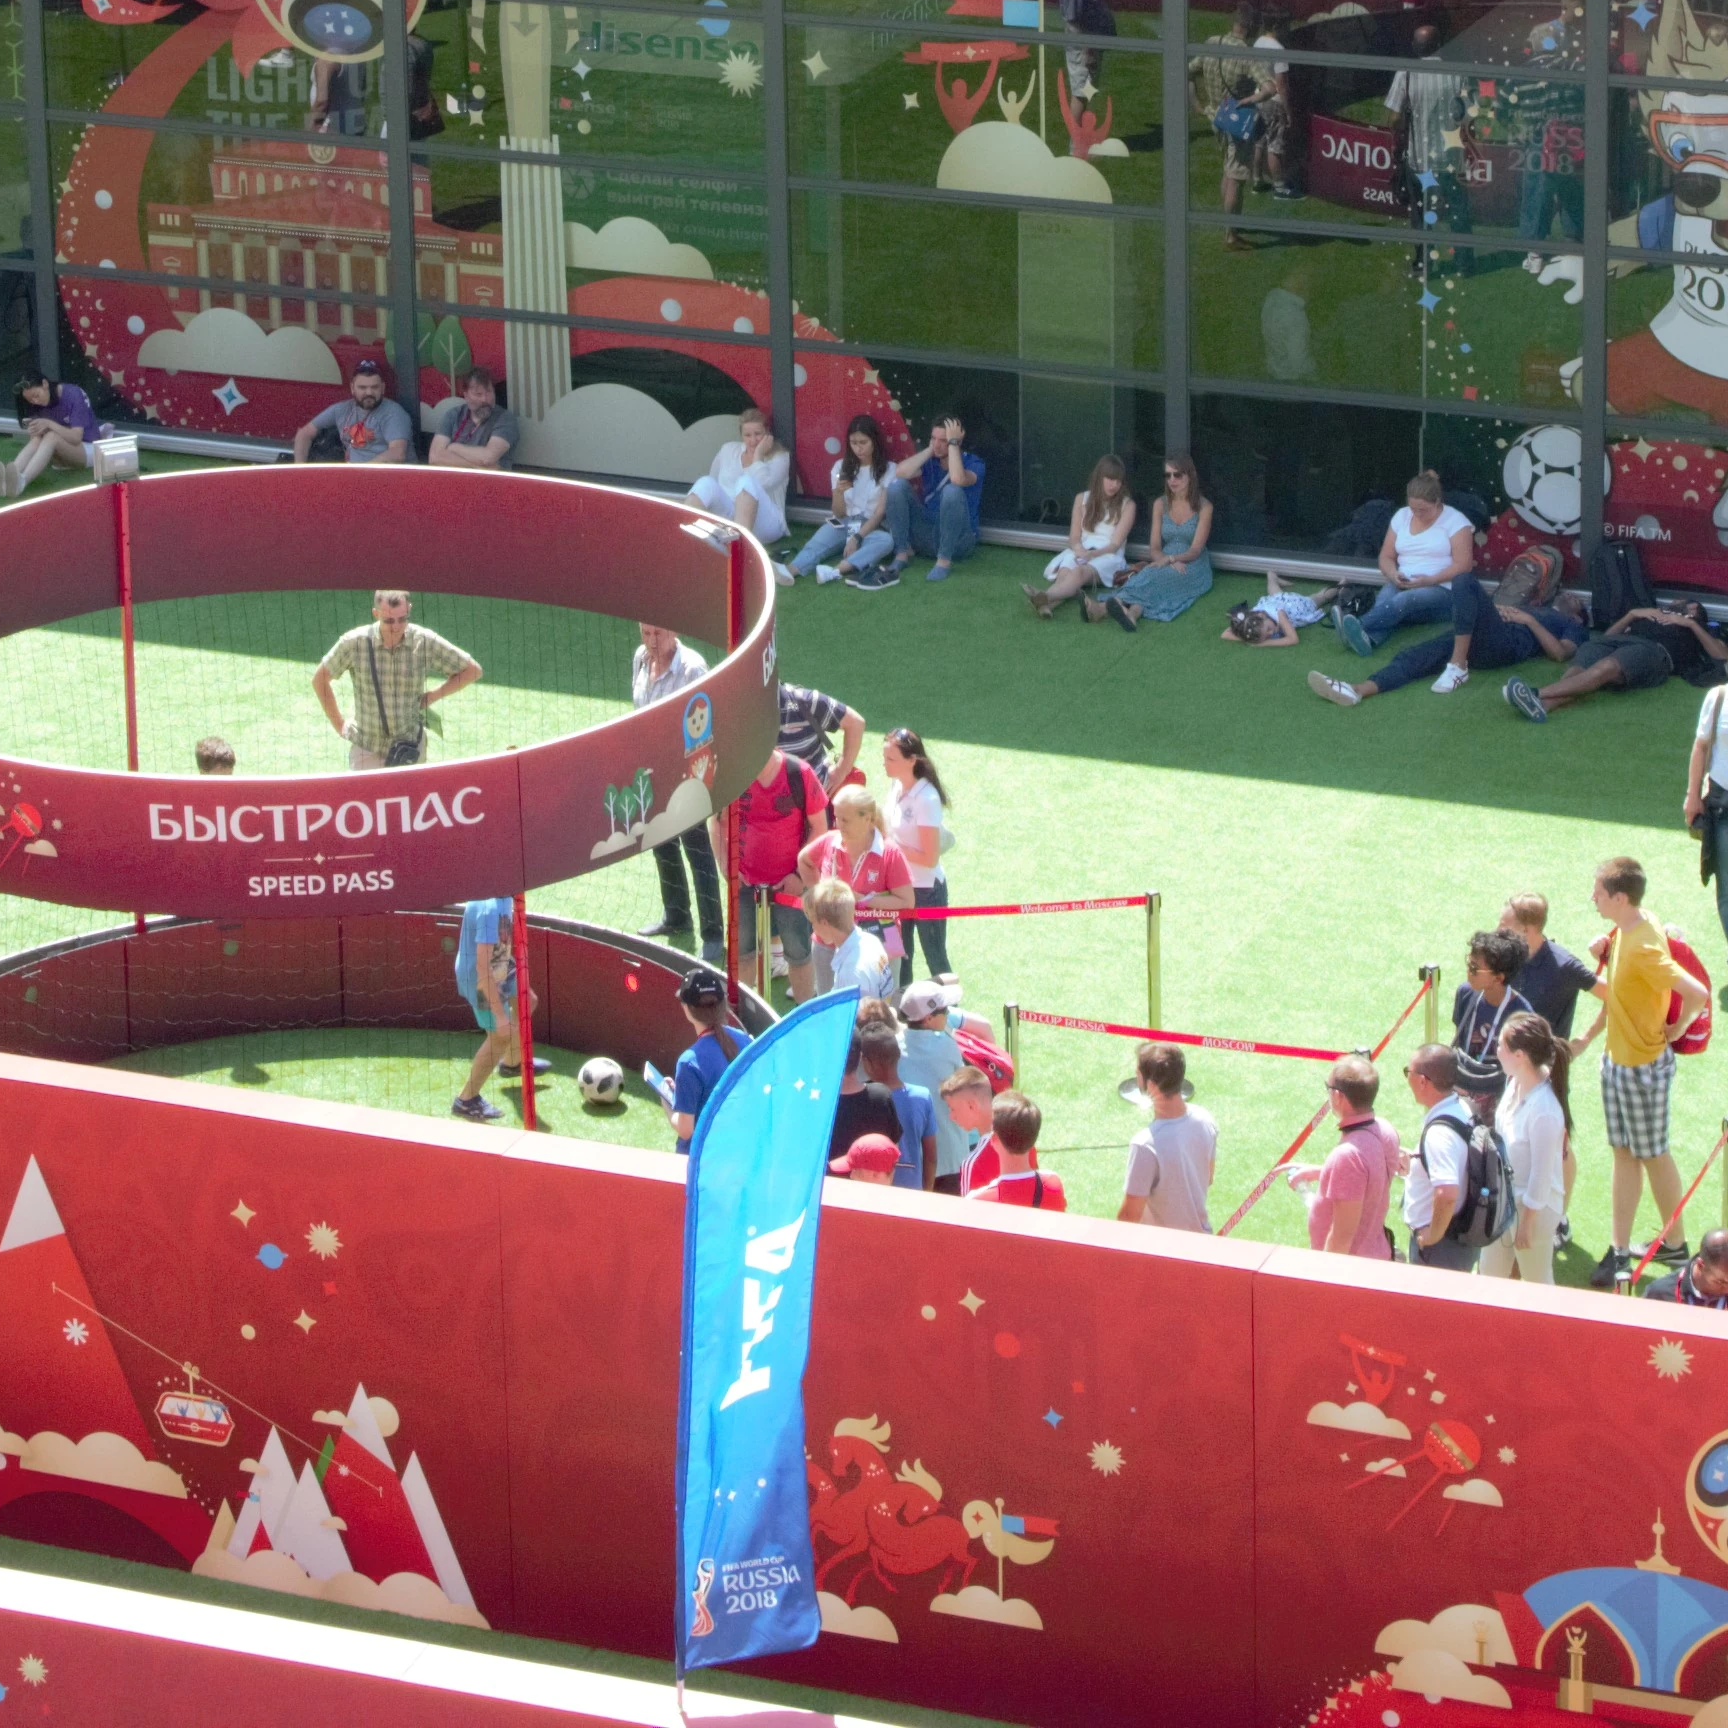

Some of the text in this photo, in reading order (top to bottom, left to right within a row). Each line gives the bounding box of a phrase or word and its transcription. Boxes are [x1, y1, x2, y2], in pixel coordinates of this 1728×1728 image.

[1618, 524, 1647, 540] FIFA
[148, 786, 485, 843] БЫСТРОПАС
[248, 869, 394, 897] SPEED PASS
[1020, 899, 1129, 914] Welcome to Moscow
[1038, 1013, 1063, 1026] CUP
[1064, 1017, 1106, 1033] RUSSIA
[1202, 1036, 1256, 1053] MOSCOW
[740, 1556, 770, 1569] WORLD
[722, 1564, 802, 1594] RUSSIA
[725, 1589, 778, 1615] 2018
